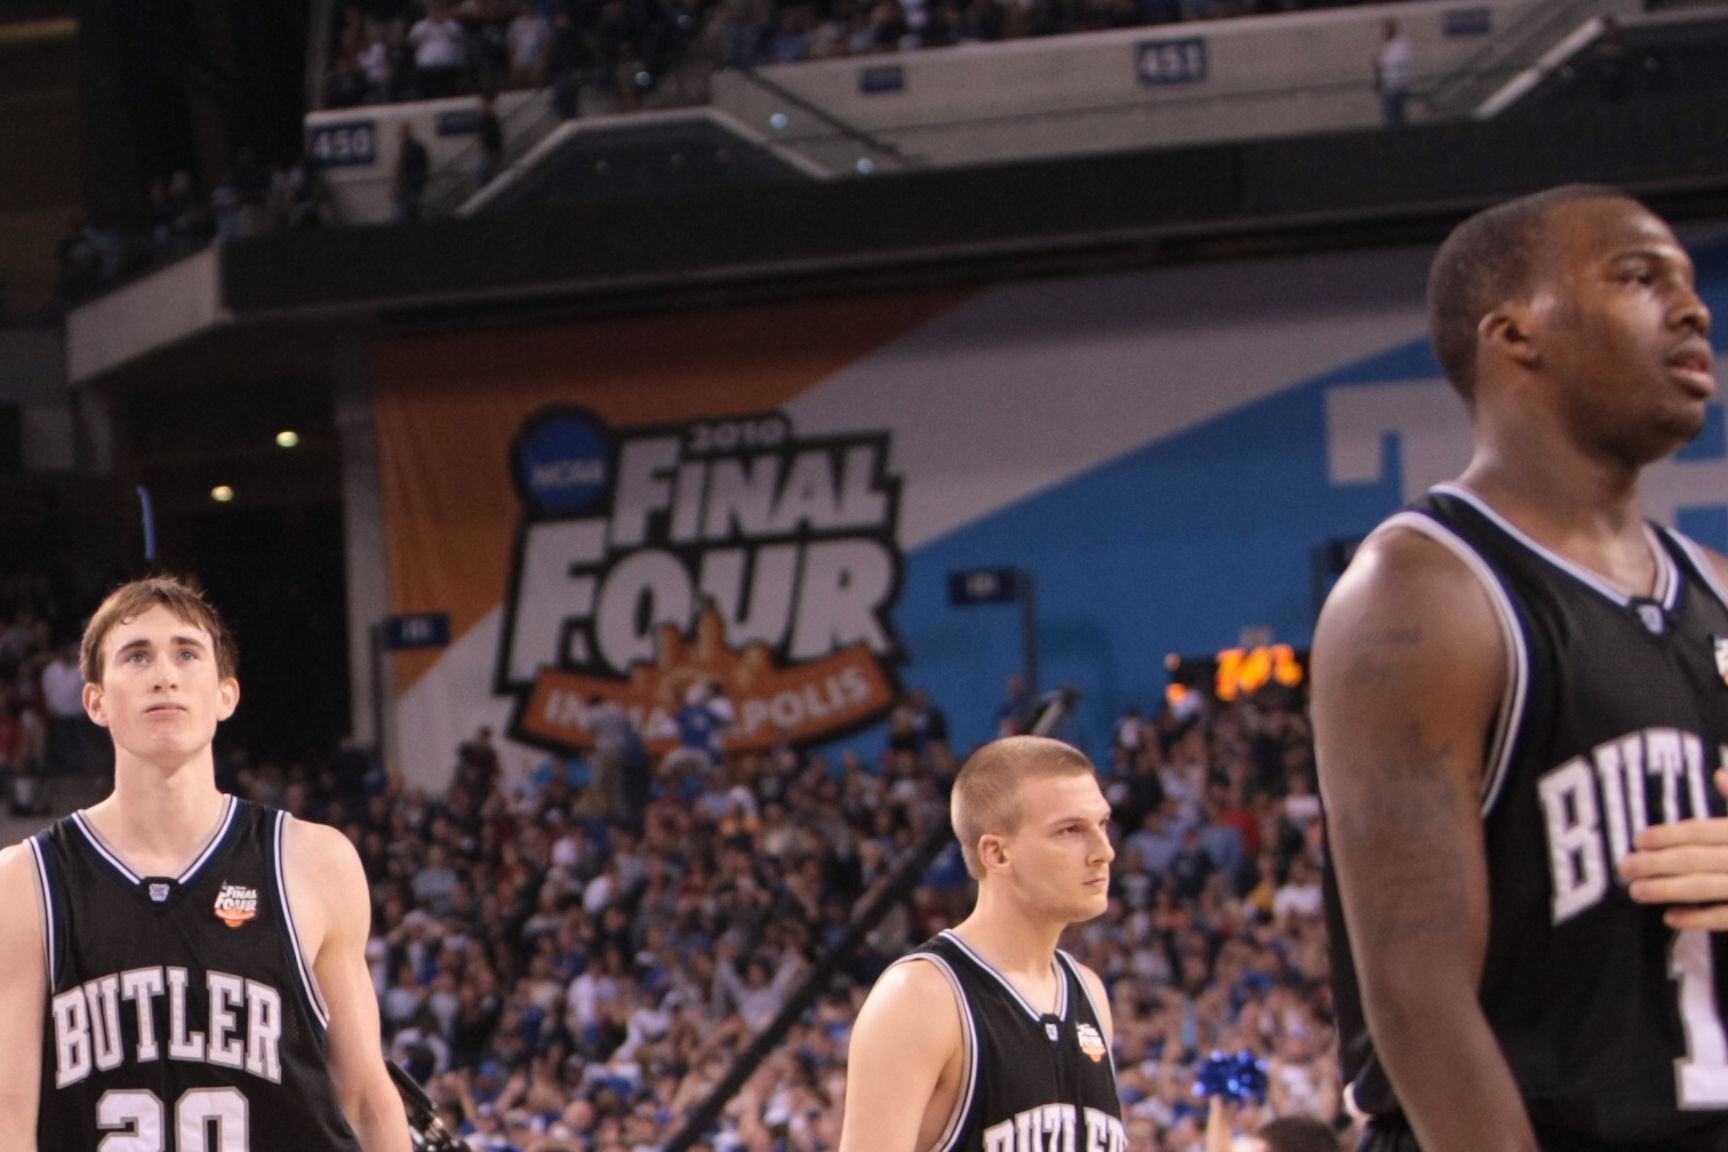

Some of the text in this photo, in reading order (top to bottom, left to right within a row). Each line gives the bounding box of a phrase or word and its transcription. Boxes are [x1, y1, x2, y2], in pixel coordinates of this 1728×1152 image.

[313, 125, 372, 160] 450
[689, 420, 786, 453] 2010
[610, 435, 889, 547] FINAL
[508, 517, 894, 685] FOUR
[214, 892, 258, 912] FOUR
[52, 966, 282, 1088] BUTLER
